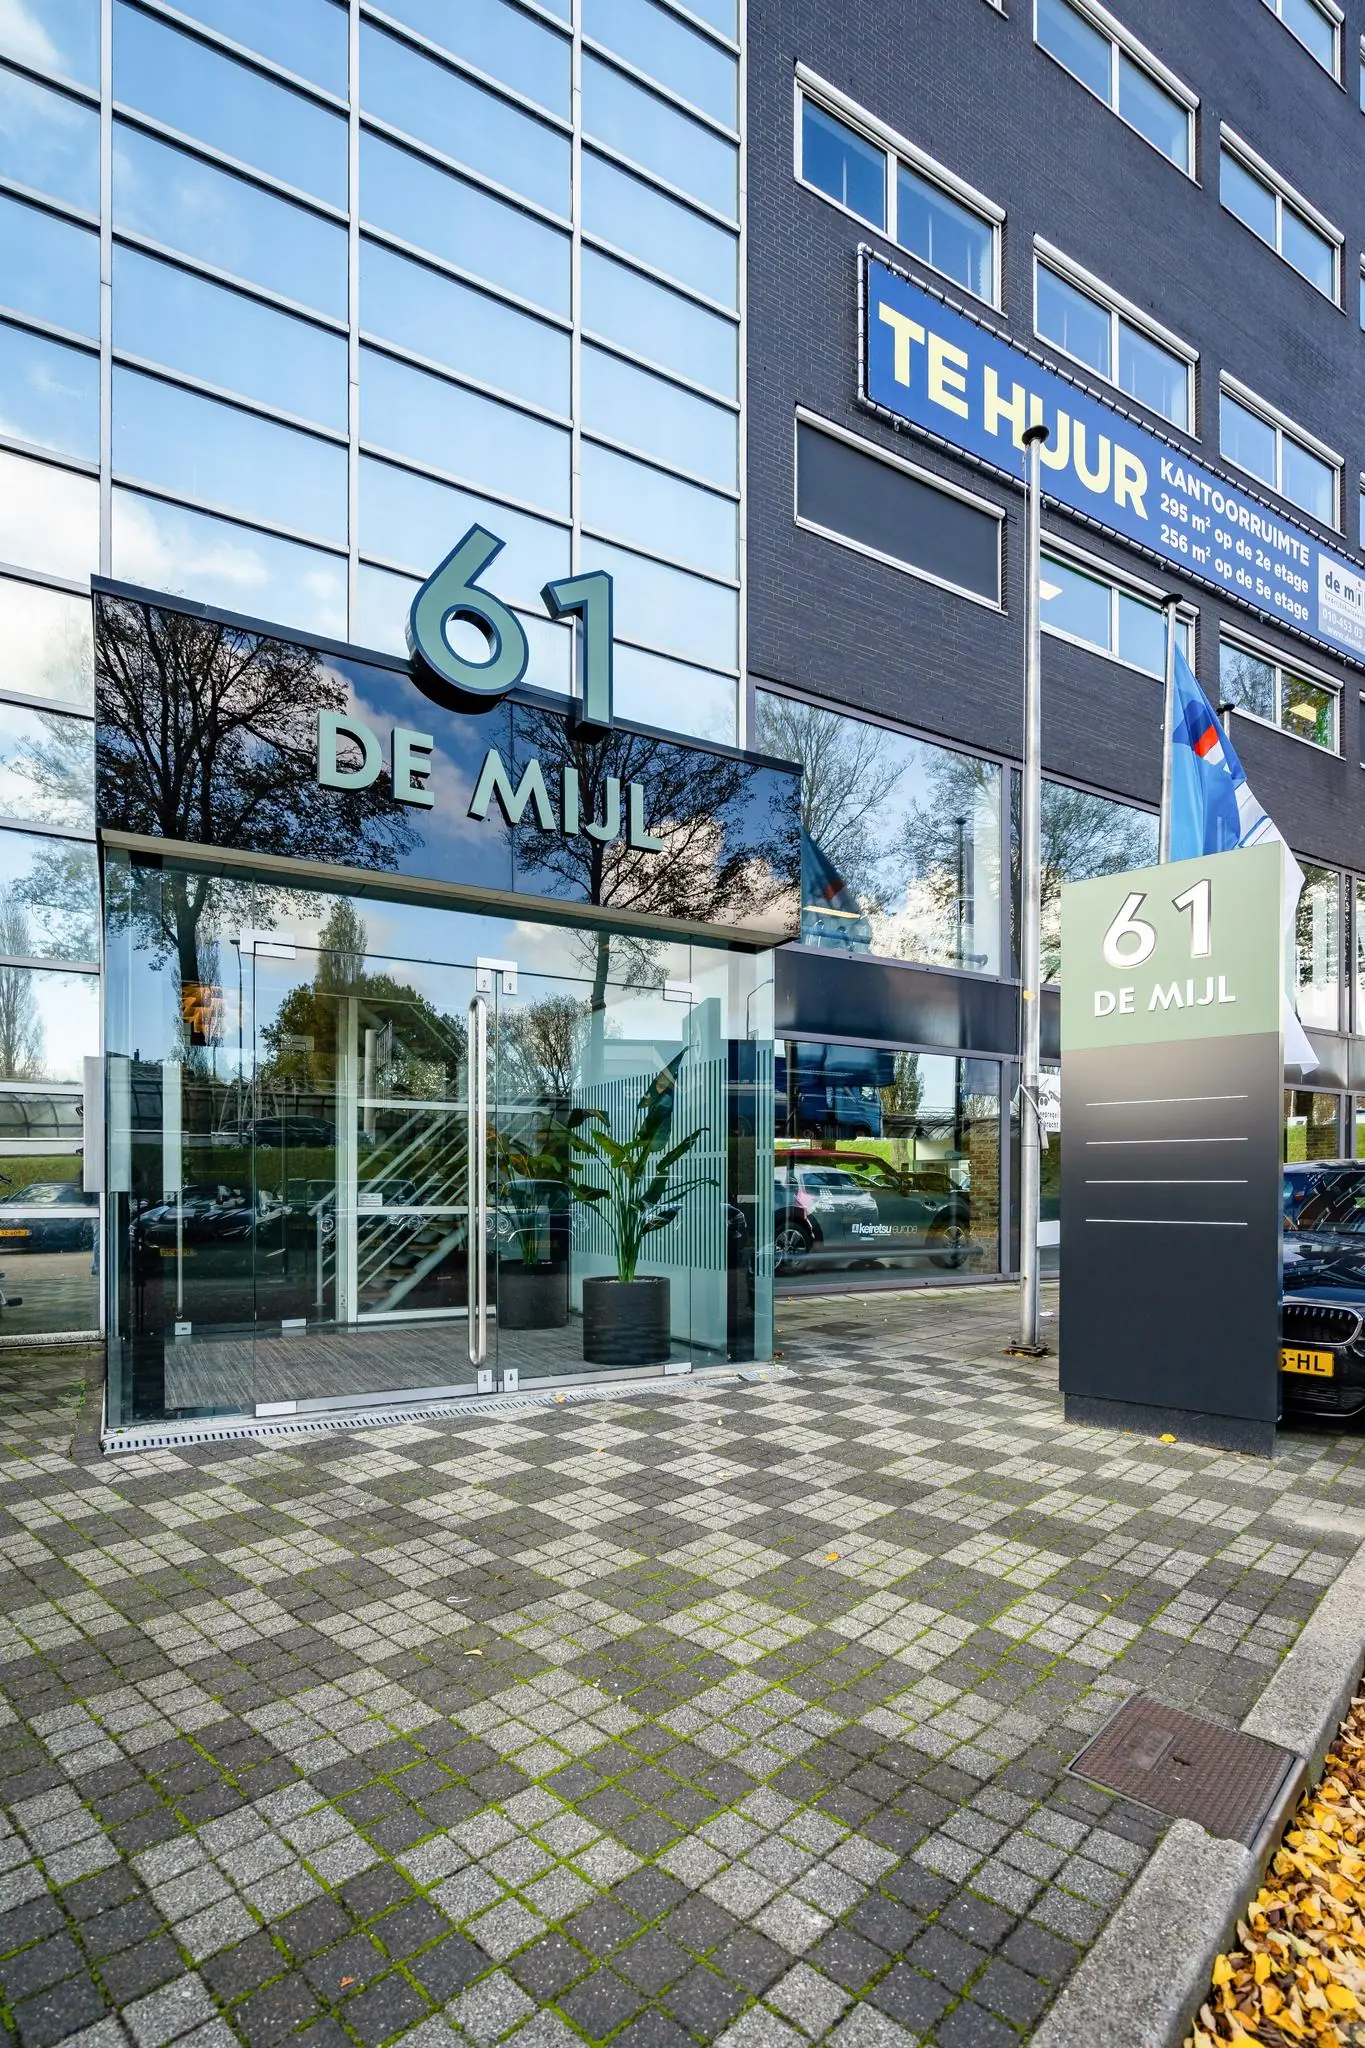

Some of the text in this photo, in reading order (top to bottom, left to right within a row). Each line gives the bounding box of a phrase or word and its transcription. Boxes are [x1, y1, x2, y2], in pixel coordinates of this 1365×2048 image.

[878, 301, 1148, 520] TE HUUR
[1160, 457, 1310, 567] KANTOORRUIMTE
[1160, 493, 1188, 523] 295
[1214, 528, 1232, 550] op
[1235, 538, 1252, 560] de
[1255, 550, 1271, 571] 2e
[1274, 563, 1309, 594] etage
[1160, 524, 1188, 554] 256
[1214, 559, 1232, 580] op
[1235, 568, 1252, 590] de
[1255, 577, 1271, 600] 5e
[1274, 591, 1309, 621] etage
[1325, 571, 1341, 594] de
[406, 522, 614, 730] 61
[318, 711, 663, 852] DE MIJL
[1102, 878, 1212, 968] 61
[1094, 976, 1237, 1017] DE MIJL
